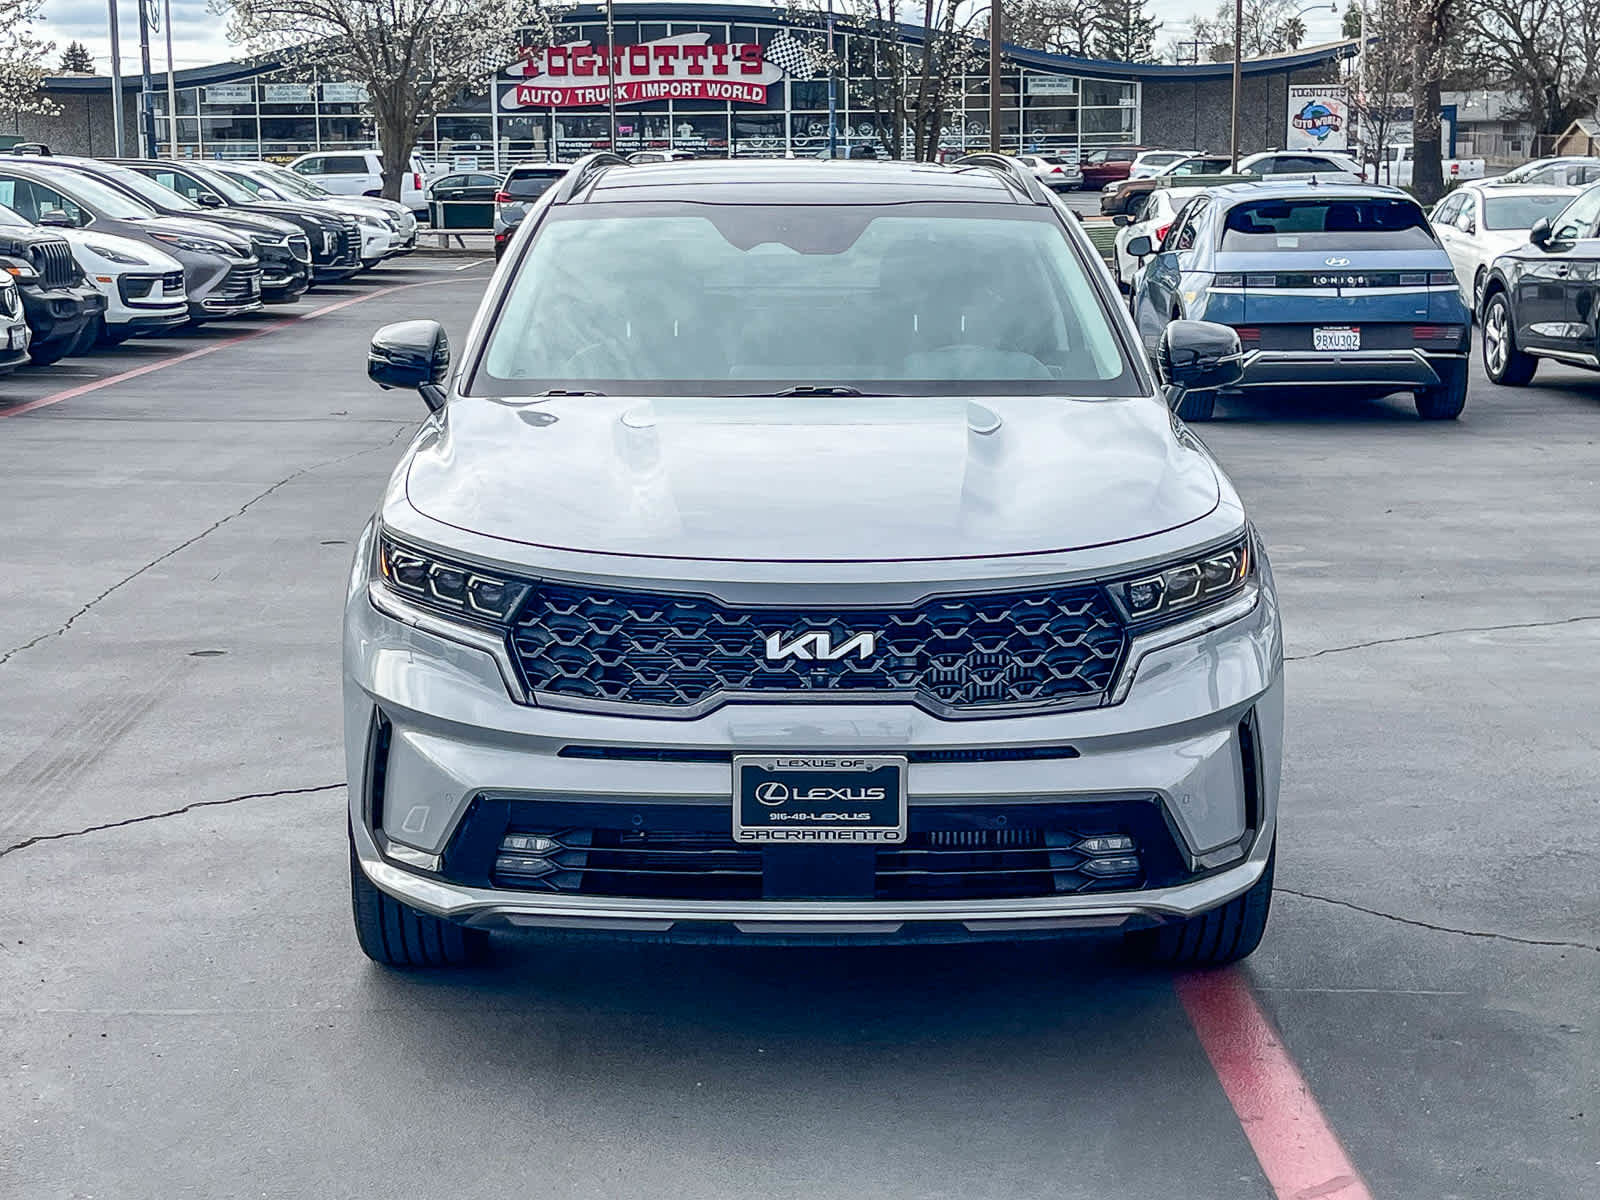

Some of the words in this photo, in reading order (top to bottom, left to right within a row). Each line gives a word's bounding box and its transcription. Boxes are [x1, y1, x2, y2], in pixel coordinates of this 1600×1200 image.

[520, 44, 763, 76] TOGNOTTI'S
[520, 89, 562, 104] AUTO
[575, 86, 628, 103] TRUCK
[641, 82, 702, 98] IMPORT
[706, 82, 763, 101] WORLD
[1315, 334, 1358, 347] 9BXU302
[766, 631, 875, 660] KIA
[776, 759, 837, 768] LEXUS
[840, 759, 865, 768] OF
[792, 787, 886, 801] LEXUS
[740, 830, 900, 841] SACRAMENTO
